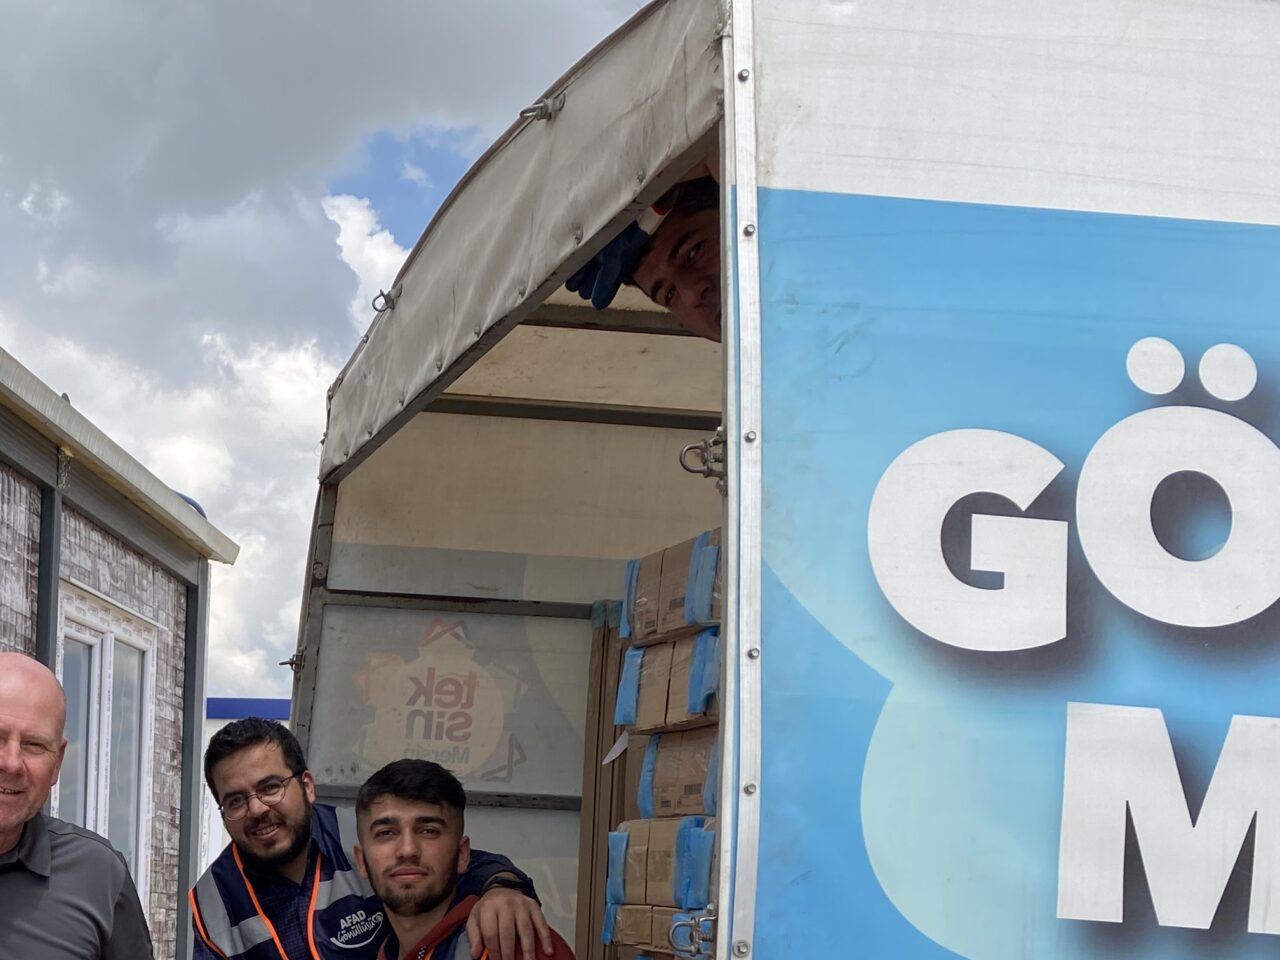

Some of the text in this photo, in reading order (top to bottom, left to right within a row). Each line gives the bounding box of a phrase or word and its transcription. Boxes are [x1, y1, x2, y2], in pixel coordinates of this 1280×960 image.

[867, 336, 1280, 651] GÖ
[340, 910, 366, 930] AFAD
[1056, 701, 1280, 936] M
